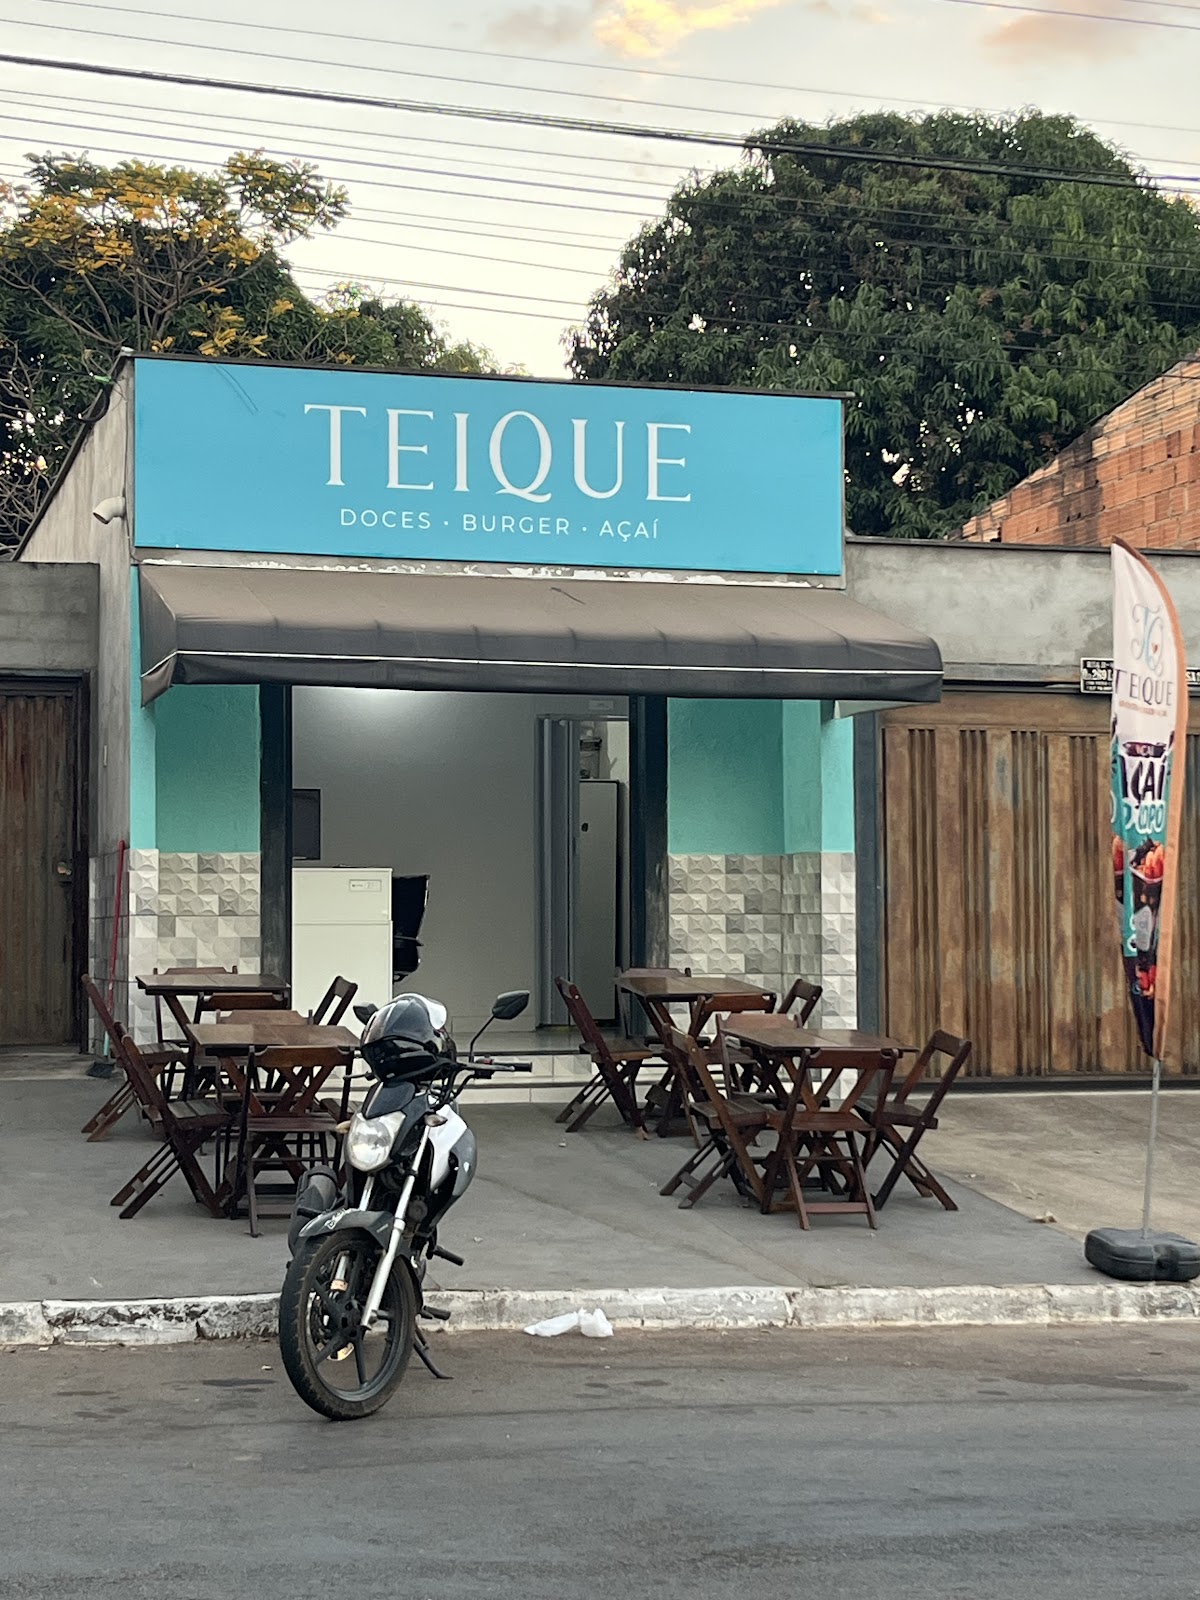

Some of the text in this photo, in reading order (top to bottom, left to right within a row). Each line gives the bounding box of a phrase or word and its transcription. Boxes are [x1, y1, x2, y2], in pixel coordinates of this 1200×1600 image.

[304, 403, 692, 503] TEIQUE
[340, 508, 658, 542] DOCES BURGER AÇAÍ
[1114, 668, 1174, 706] TEIQUE
